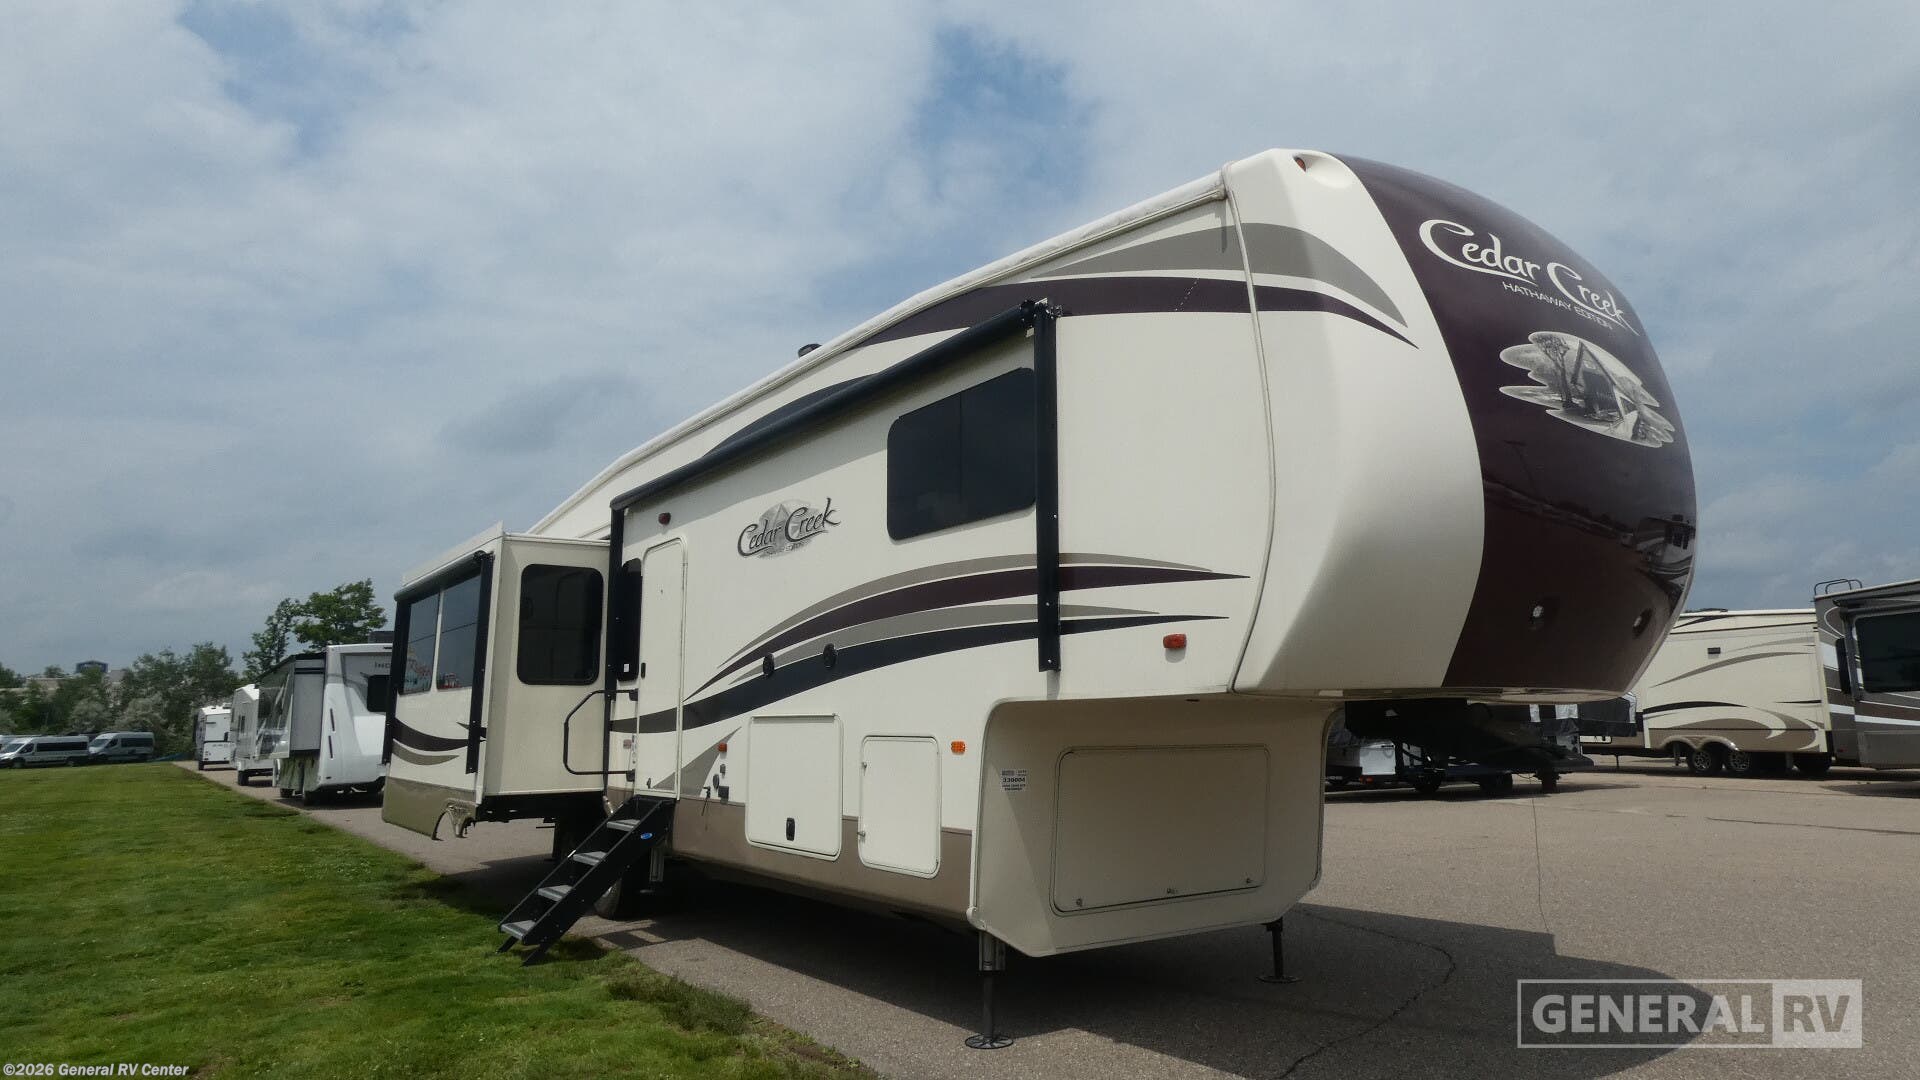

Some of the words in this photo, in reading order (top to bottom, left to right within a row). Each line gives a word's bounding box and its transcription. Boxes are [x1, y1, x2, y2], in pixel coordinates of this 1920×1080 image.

[1419, 219, 1541, 286] Cedar
[1547, 262, 1640, 337] Creek
[1502, 281, 1572, 311] HATHAWAY
[738, 519, 782, 557] Cedar
[784, 497, 841, 543] Creek
